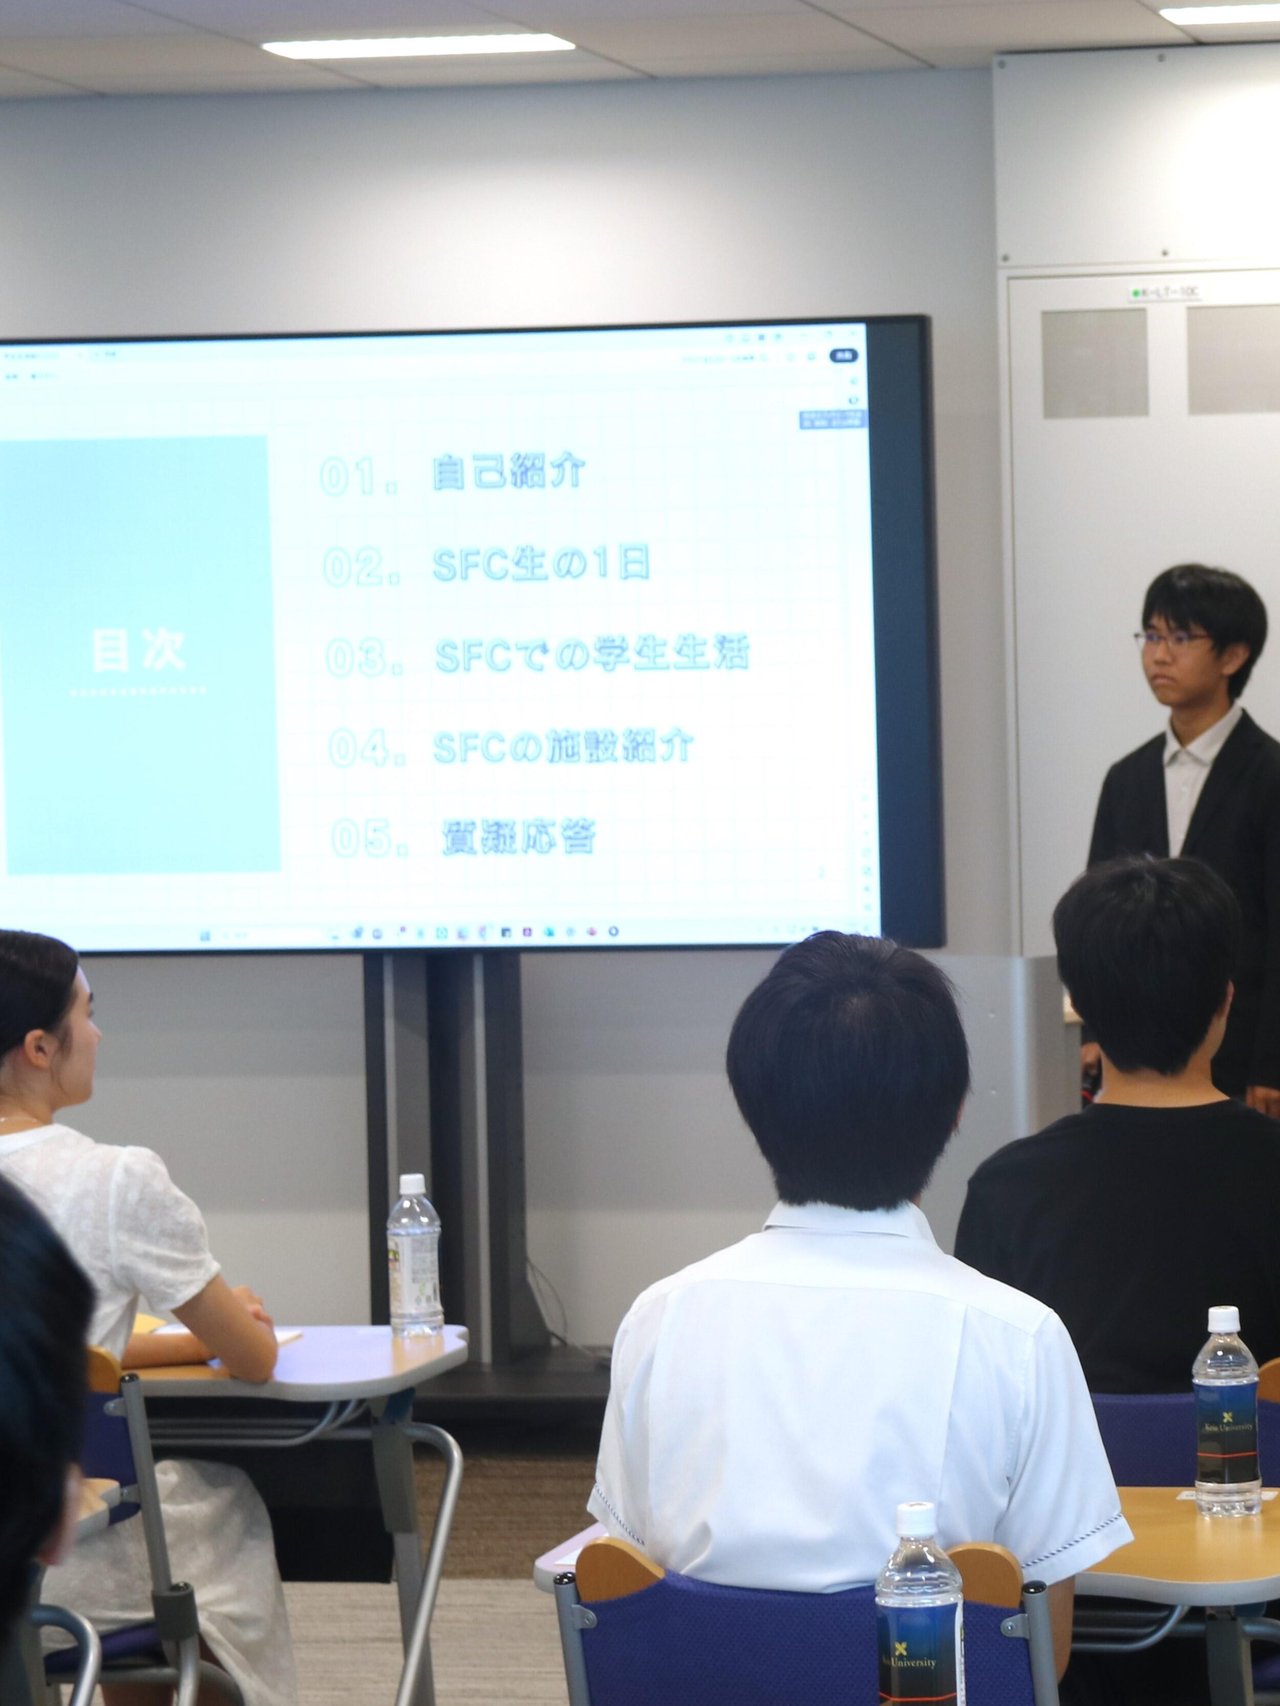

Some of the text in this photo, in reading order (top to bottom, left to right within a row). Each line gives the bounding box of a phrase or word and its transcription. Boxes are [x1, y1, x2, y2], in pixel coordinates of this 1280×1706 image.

[320, 451, 586, 496] 01. 自己紹介
[323, 543, 650, 588] 02. SFC生の1日
[93, 627, 187, 672] 目次
[325, 633, 750, 677] 03. SFCでの学生生活
[329, 727, 695, 767] 04. SFCの施設紹介
[331, 818, 597, 858] 05. 質疑応答
[891, 1656, 937, 1669] University
